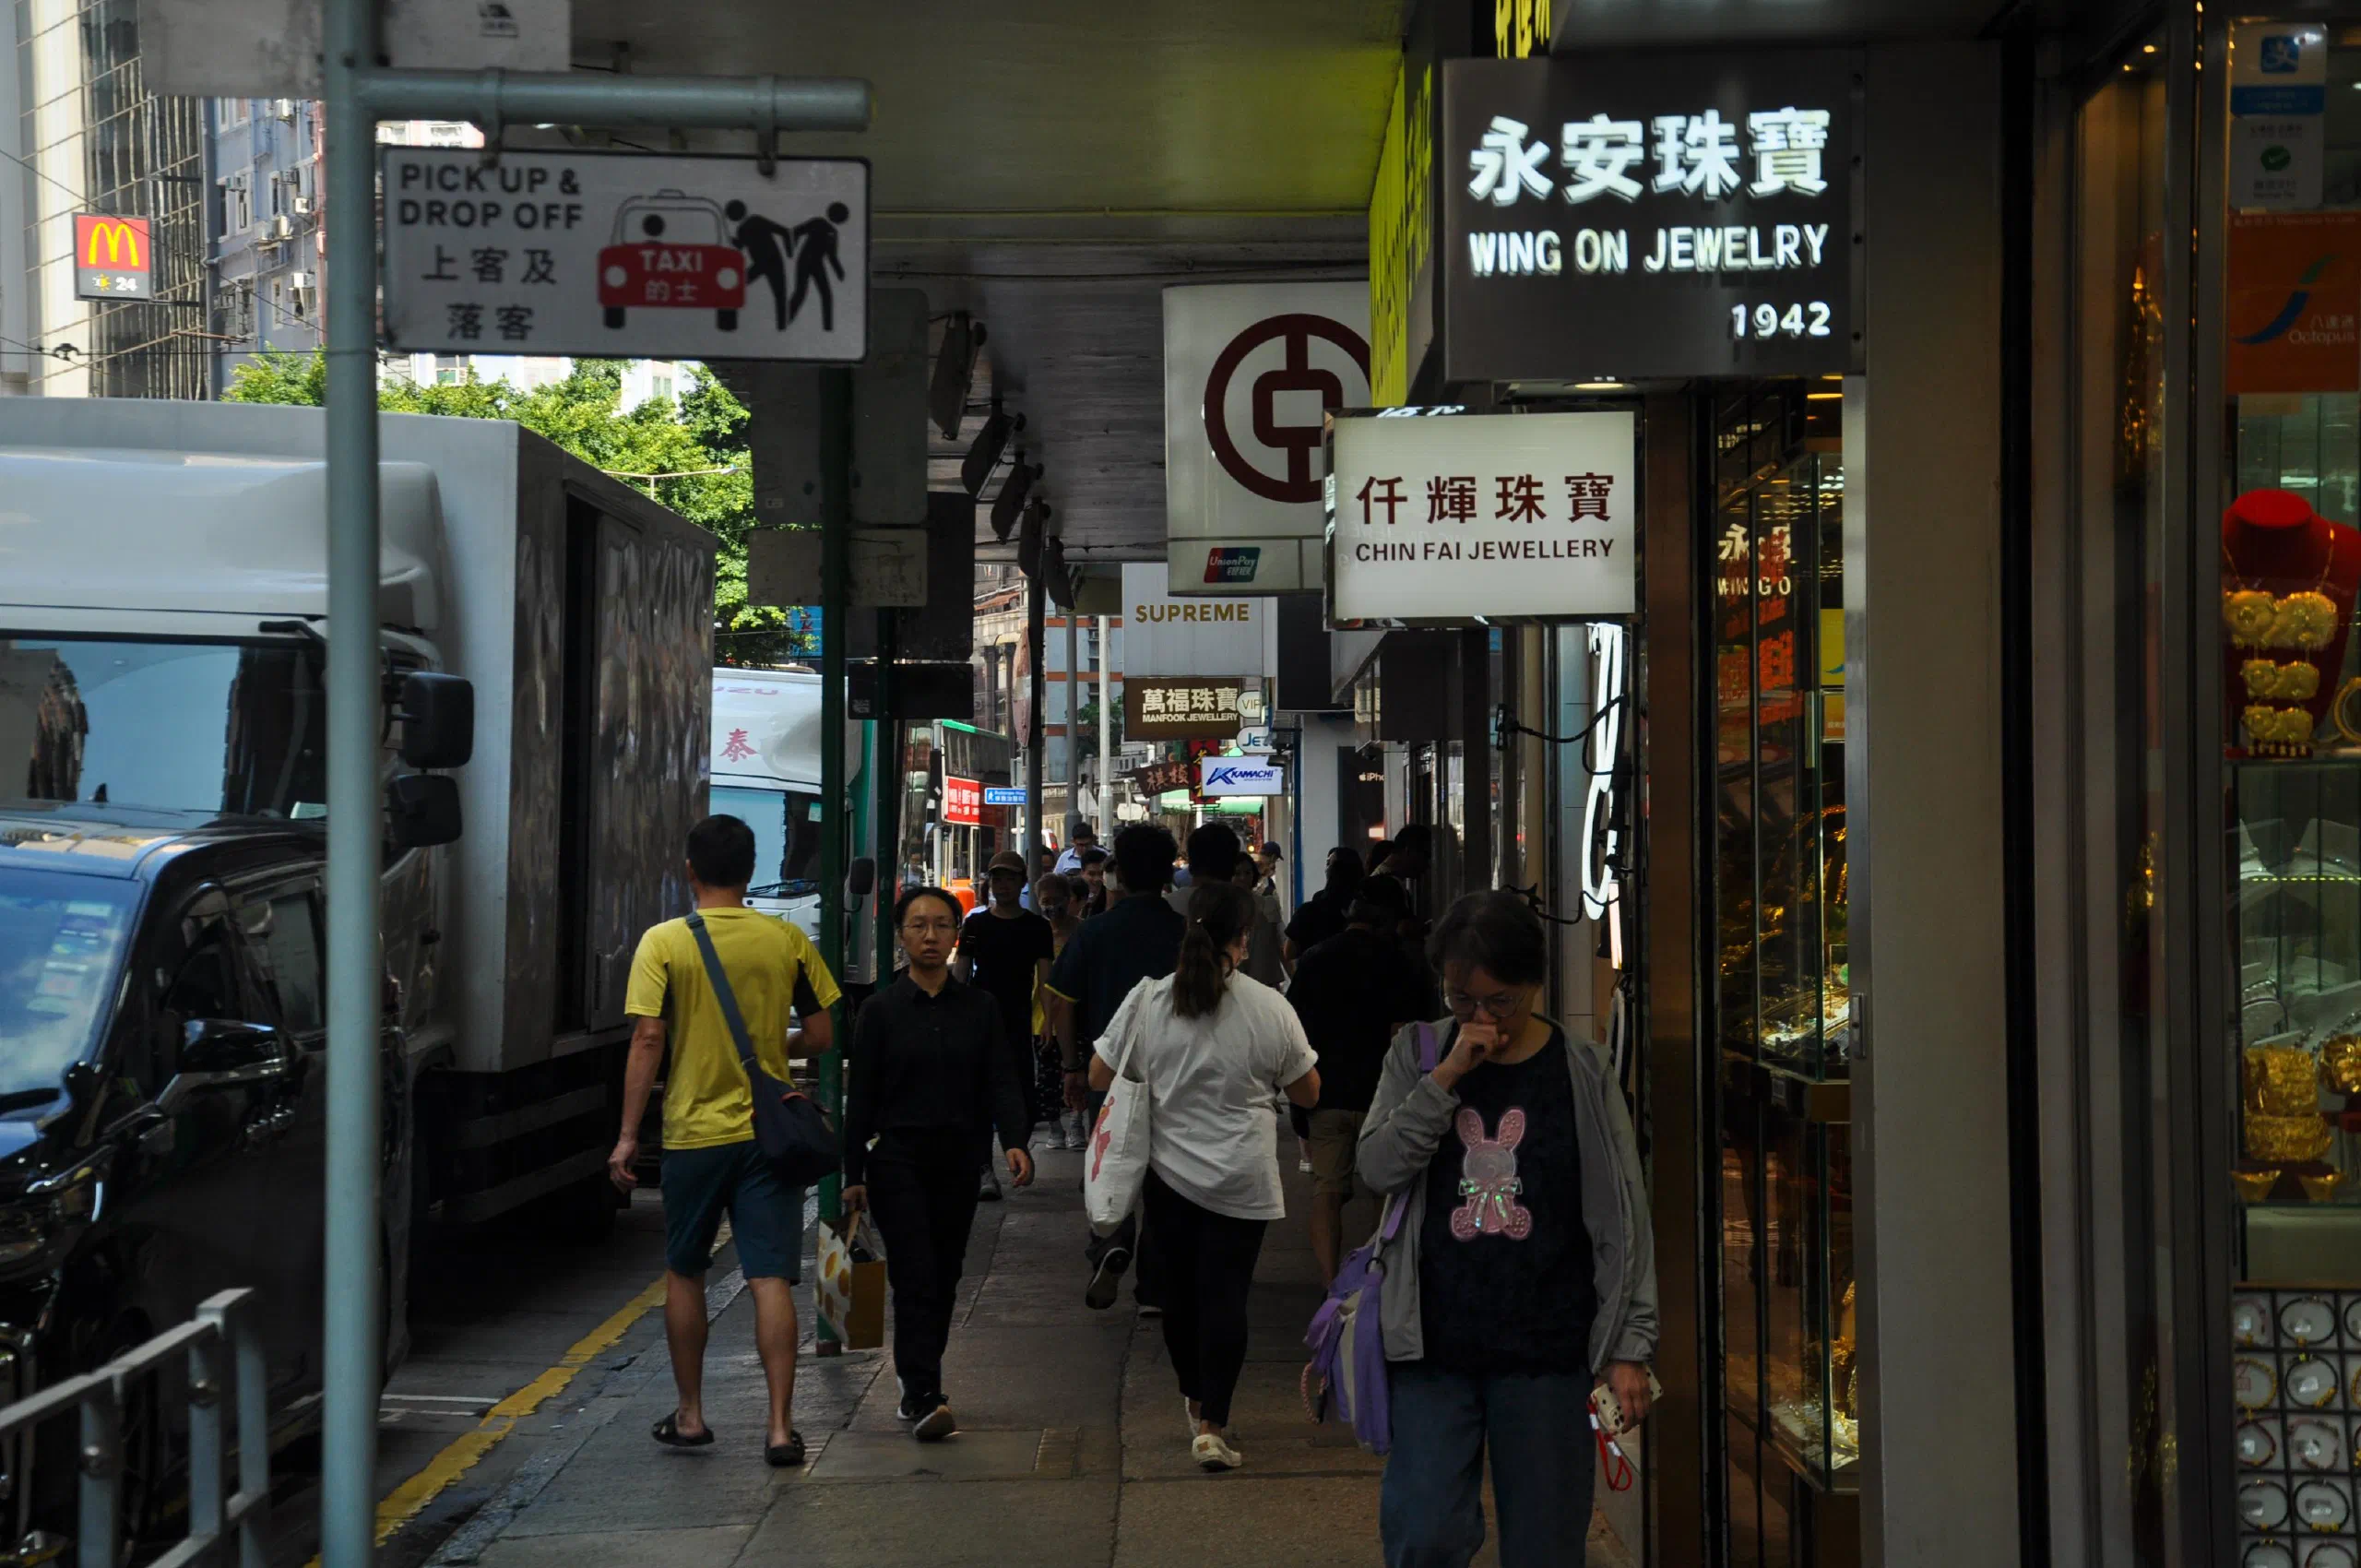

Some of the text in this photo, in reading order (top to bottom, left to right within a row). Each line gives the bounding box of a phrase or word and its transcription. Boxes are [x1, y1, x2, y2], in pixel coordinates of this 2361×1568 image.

[1468, 106, 1832, 207] 永安珠寶
[400, 163, 582, 196] PICK UP &
[397, 199, 583, 230] DROP OFF
[421, 244, 559, 284] 上客及
[639, 249, 703, 273] TAXI
[1468, 223, 1829, 277] WING ON JEWELRY
[115, 277, 137, 291] 24
[644, 279, 698, 302] 的士
[446, 303, 535, 341] 落客
[1730, 301, 1831, 339] 1942
[1356, 472, 1614, 524] 仟輝珠寶
[1208, 555, 1256, 566] UnionPay
[1356, 539, 1614, 562] CHIN FAI JEWELLERY
[1135, 603, 1250, 623] SUPREME
[1142, 687, 1239, 713] 萬福珠寶
[1187, 712, 1239, 722] JEWELLERY
[719, 728, 760, 763] 泰
[1231, 769, 1274, 778] KAMACHI
